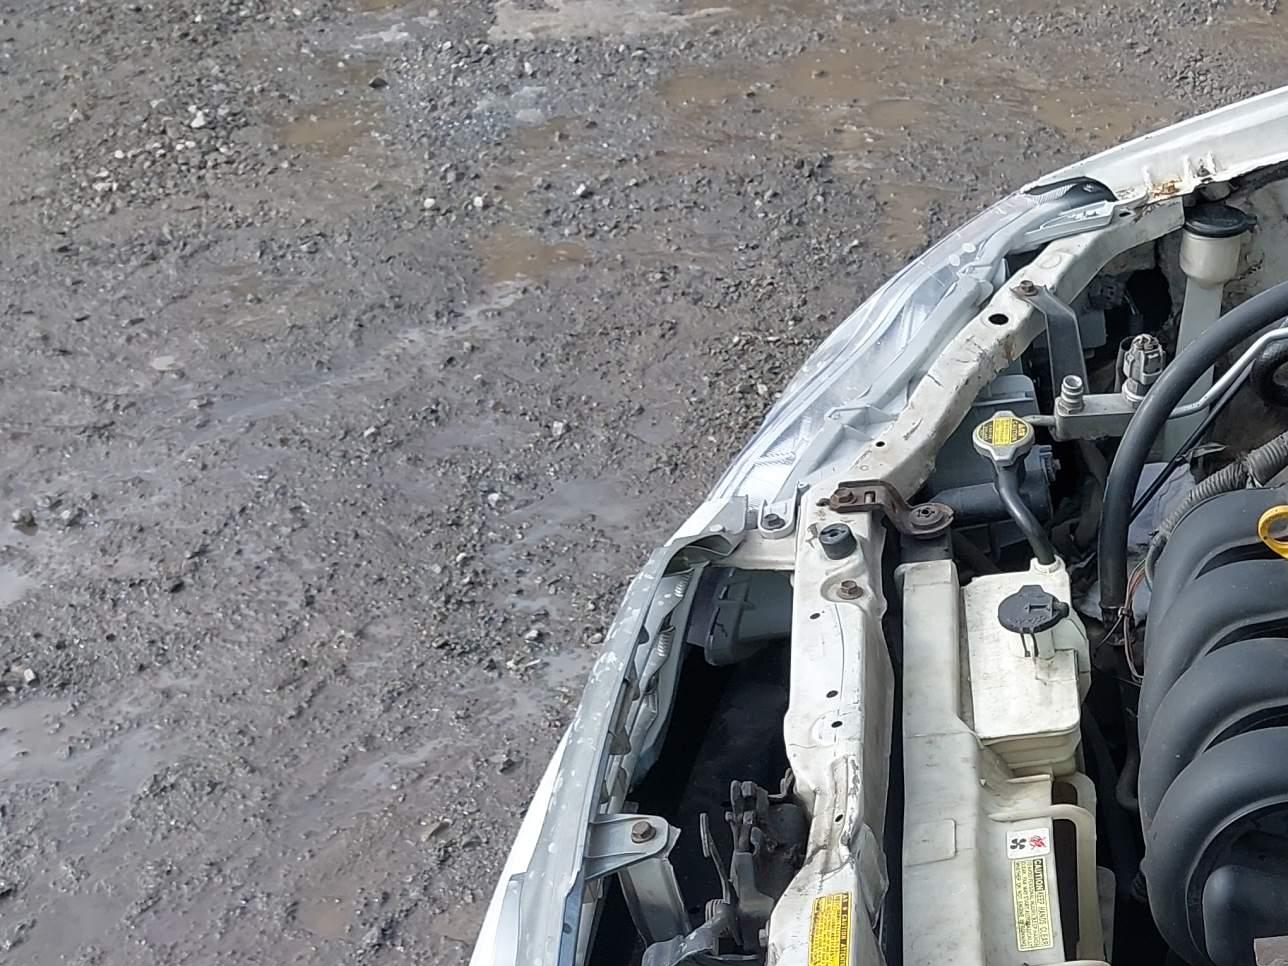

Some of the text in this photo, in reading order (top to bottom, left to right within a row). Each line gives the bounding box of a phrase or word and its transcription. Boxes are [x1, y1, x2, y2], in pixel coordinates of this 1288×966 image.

[1034, 860, 1044, 891] CAUTION
[1036, 891, 1045, 904] KEEP
[1039, 906, 1047, 925] HANDS
